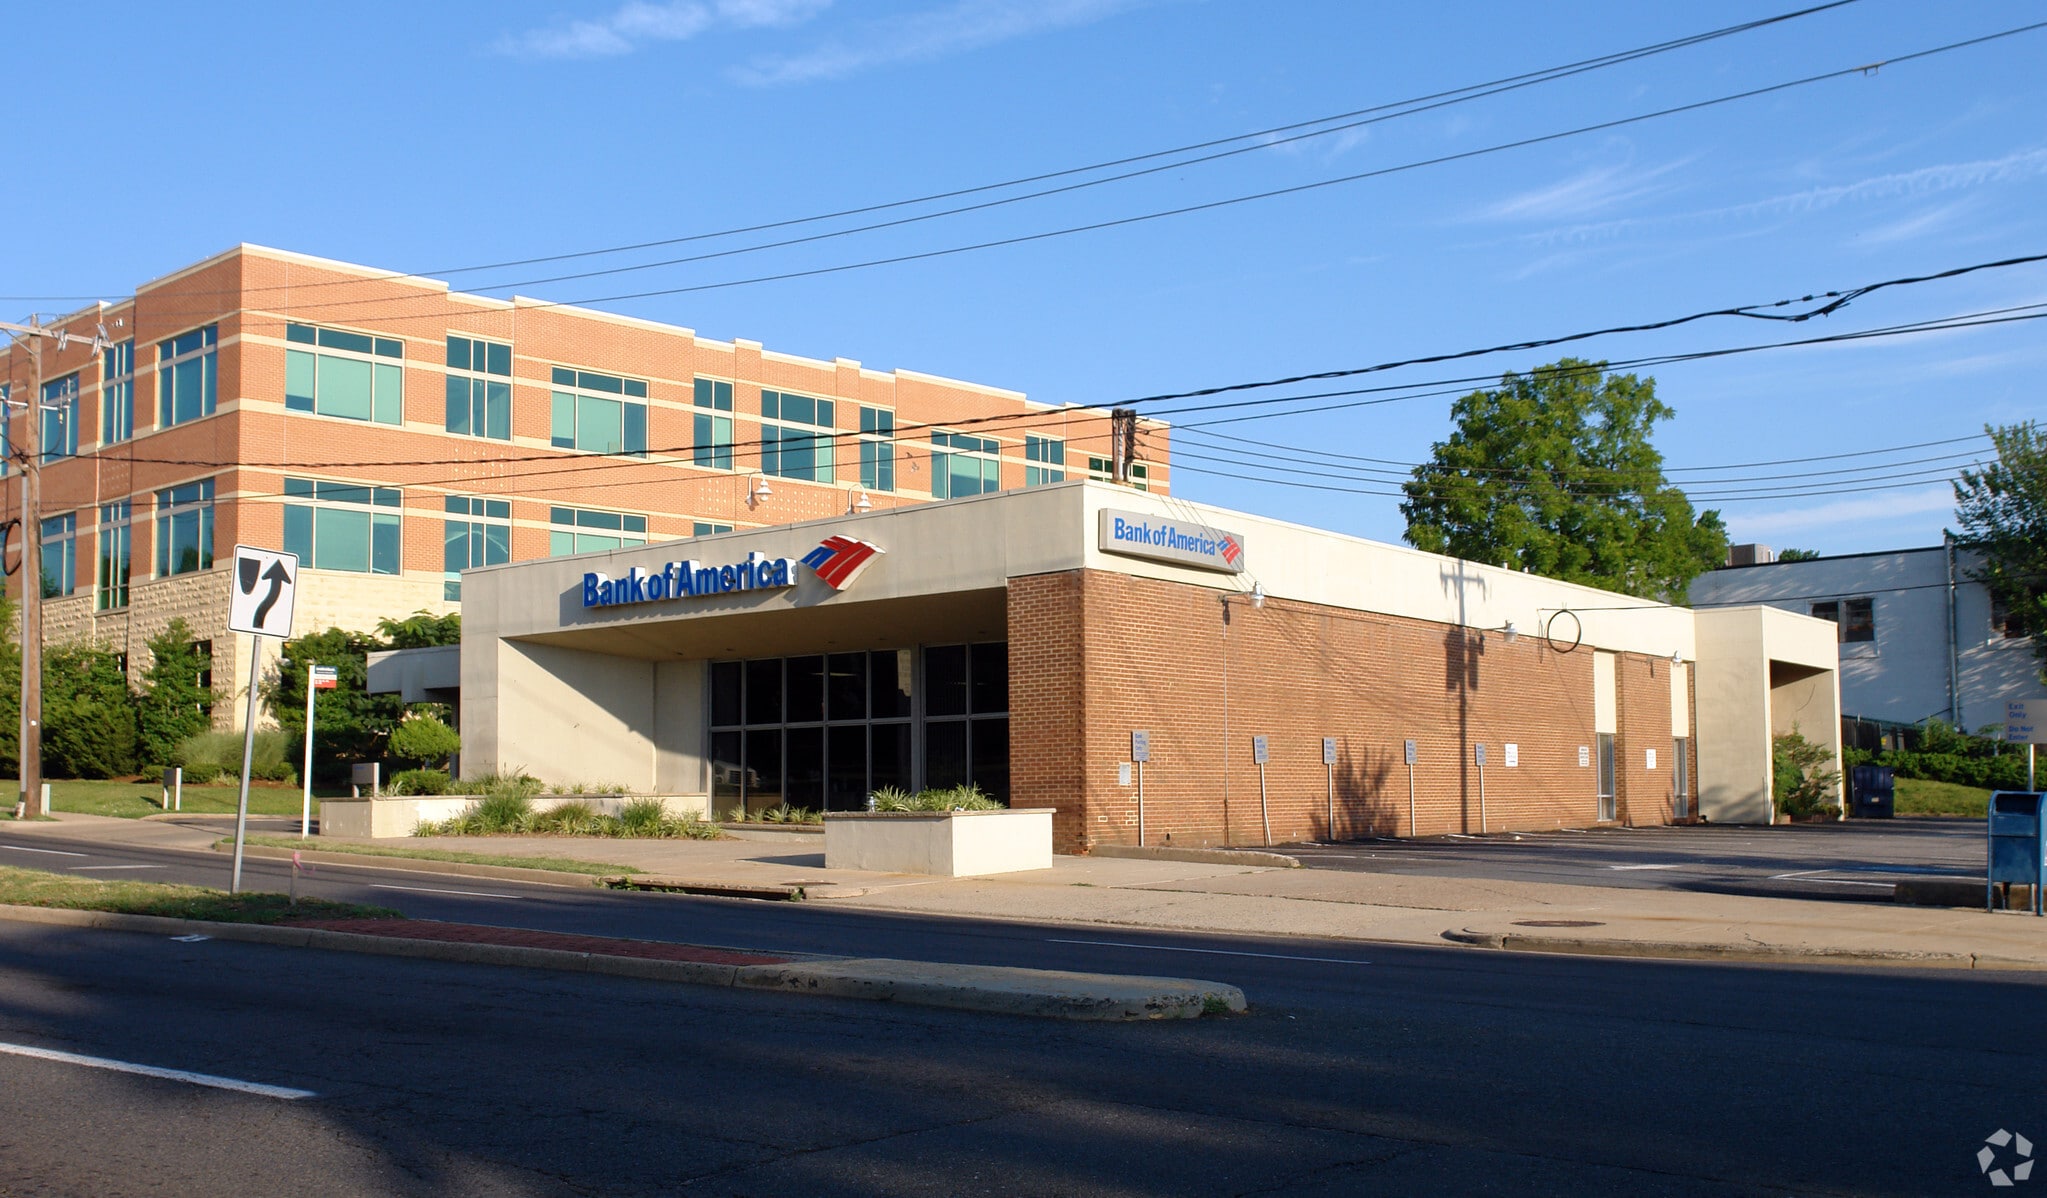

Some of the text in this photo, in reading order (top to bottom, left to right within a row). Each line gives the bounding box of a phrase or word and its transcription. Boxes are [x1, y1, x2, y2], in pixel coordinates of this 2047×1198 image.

[1114, 518, 1216, 556] Bank of America
[583, 552, 790, 608] Bank of America
[2009, 711, 2027, 719] Only
